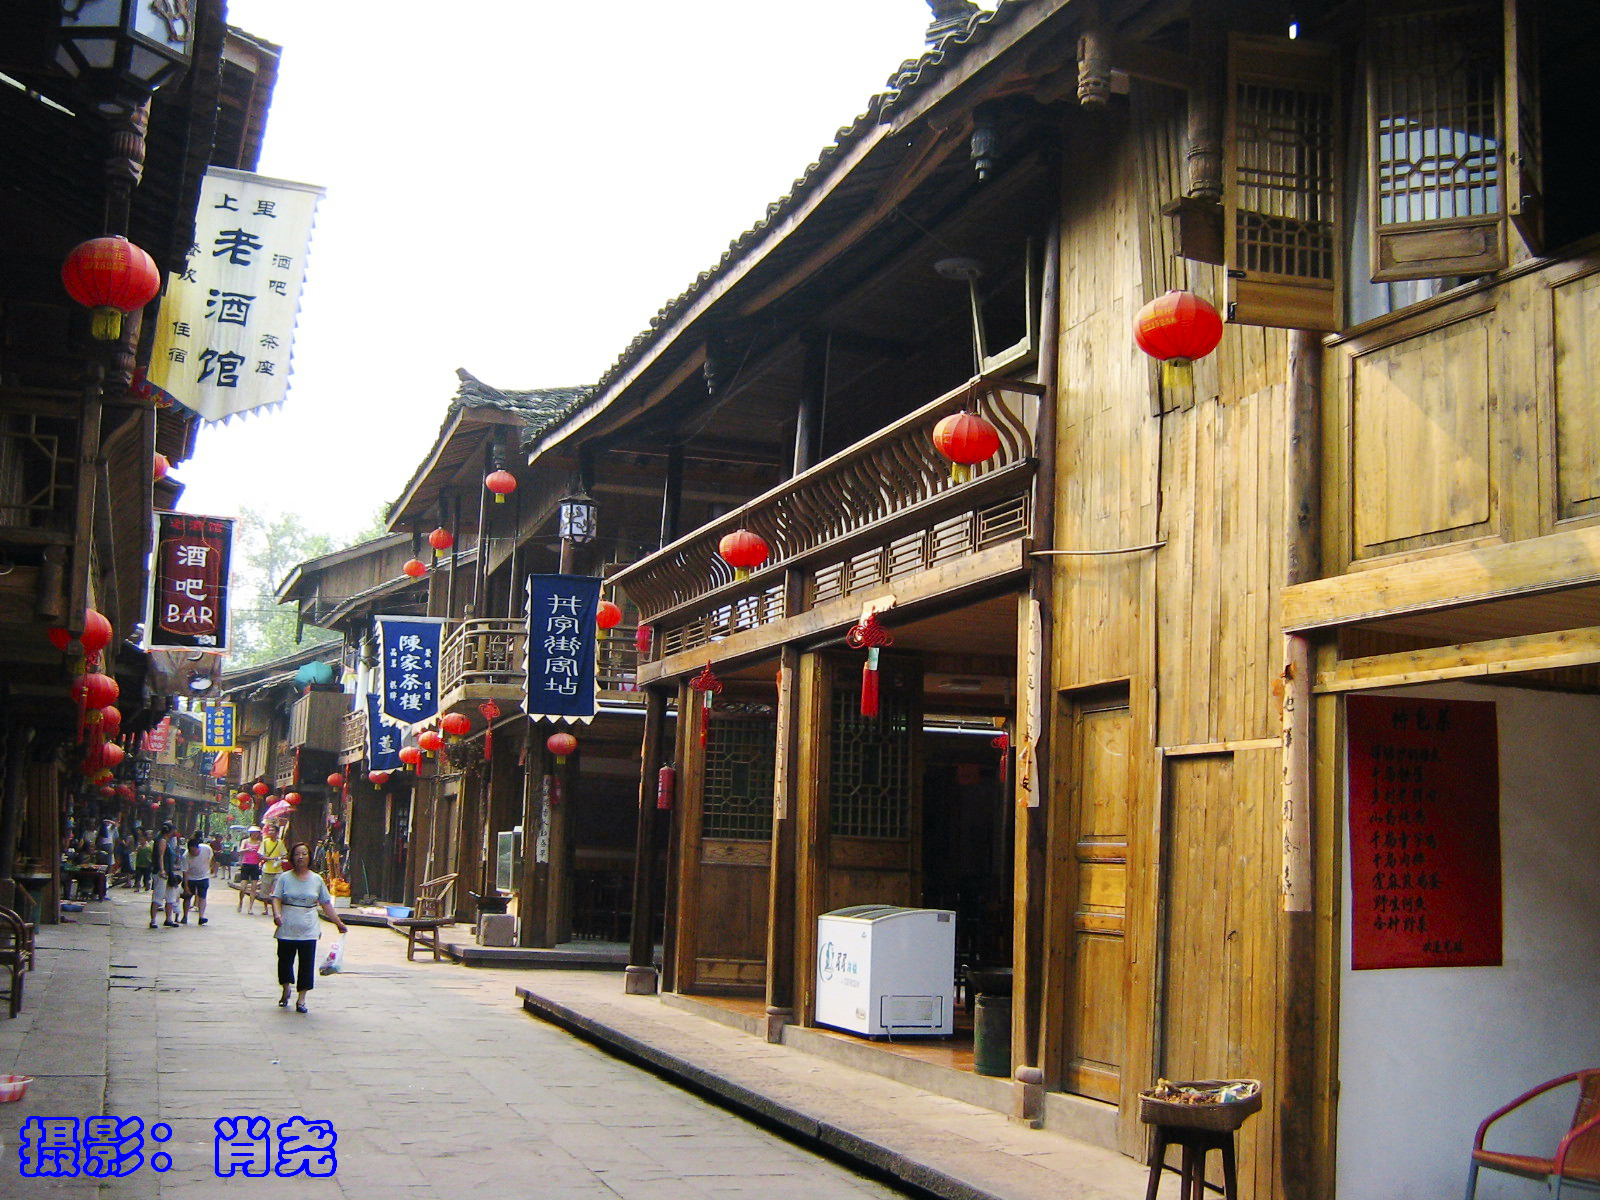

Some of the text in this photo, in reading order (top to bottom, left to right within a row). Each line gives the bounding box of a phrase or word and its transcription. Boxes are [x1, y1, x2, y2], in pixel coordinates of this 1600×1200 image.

[213, 193, 278, 219] 上里
[197, 227, 263, 388] 老酒馆
[255, 253, 294, 377] 酒吧 茶座
[168, 320, 192, 364] 住宿
[174, 544, 212, 602] 酒吧
[166, 603, 215, 625] BAR
[398, 634, 424, 711] 陳家茶樓
